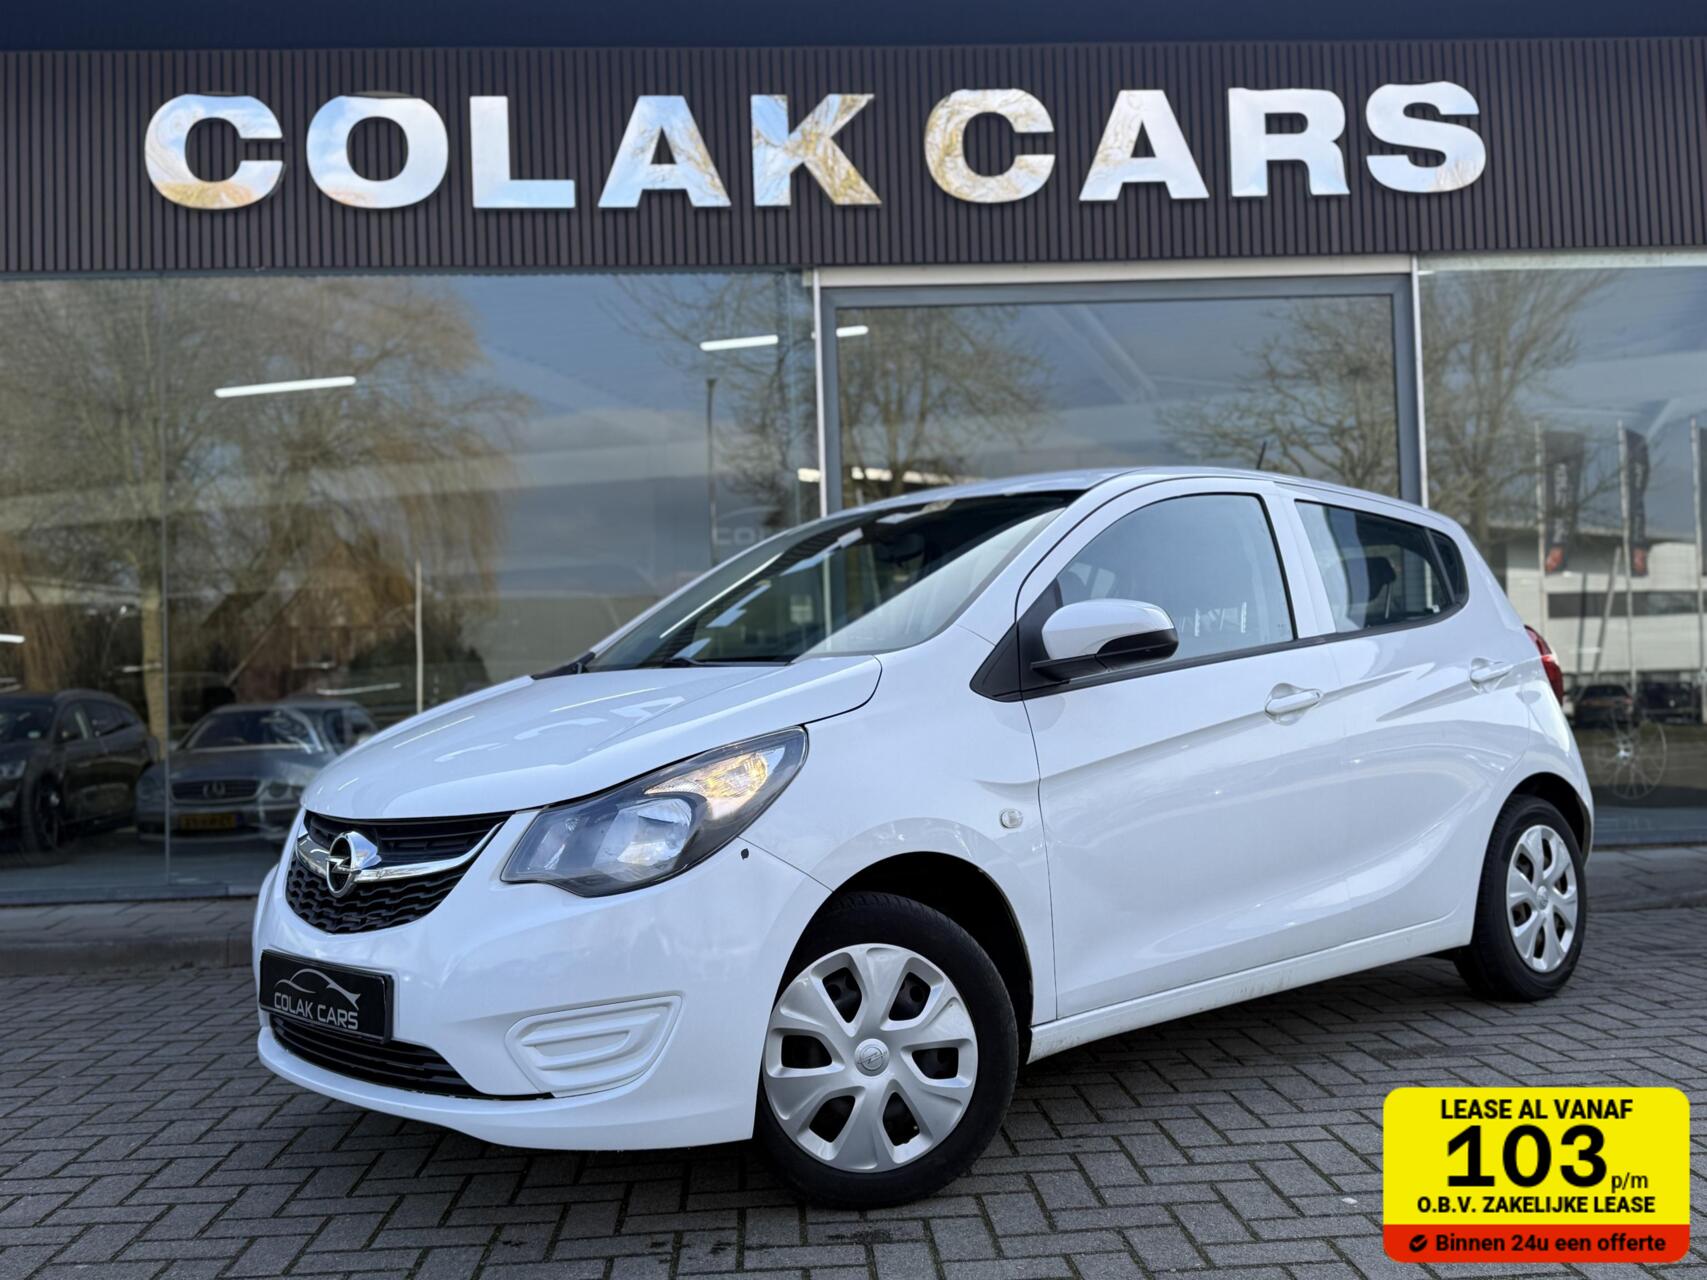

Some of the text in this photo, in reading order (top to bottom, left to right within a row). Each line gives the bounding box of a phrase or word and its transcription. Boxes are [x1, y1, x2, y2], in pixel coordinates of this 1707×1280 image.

[144, 80, 1487, 209] COLAK CARS
[274, 992, 358, 1030] COLAK CARS
